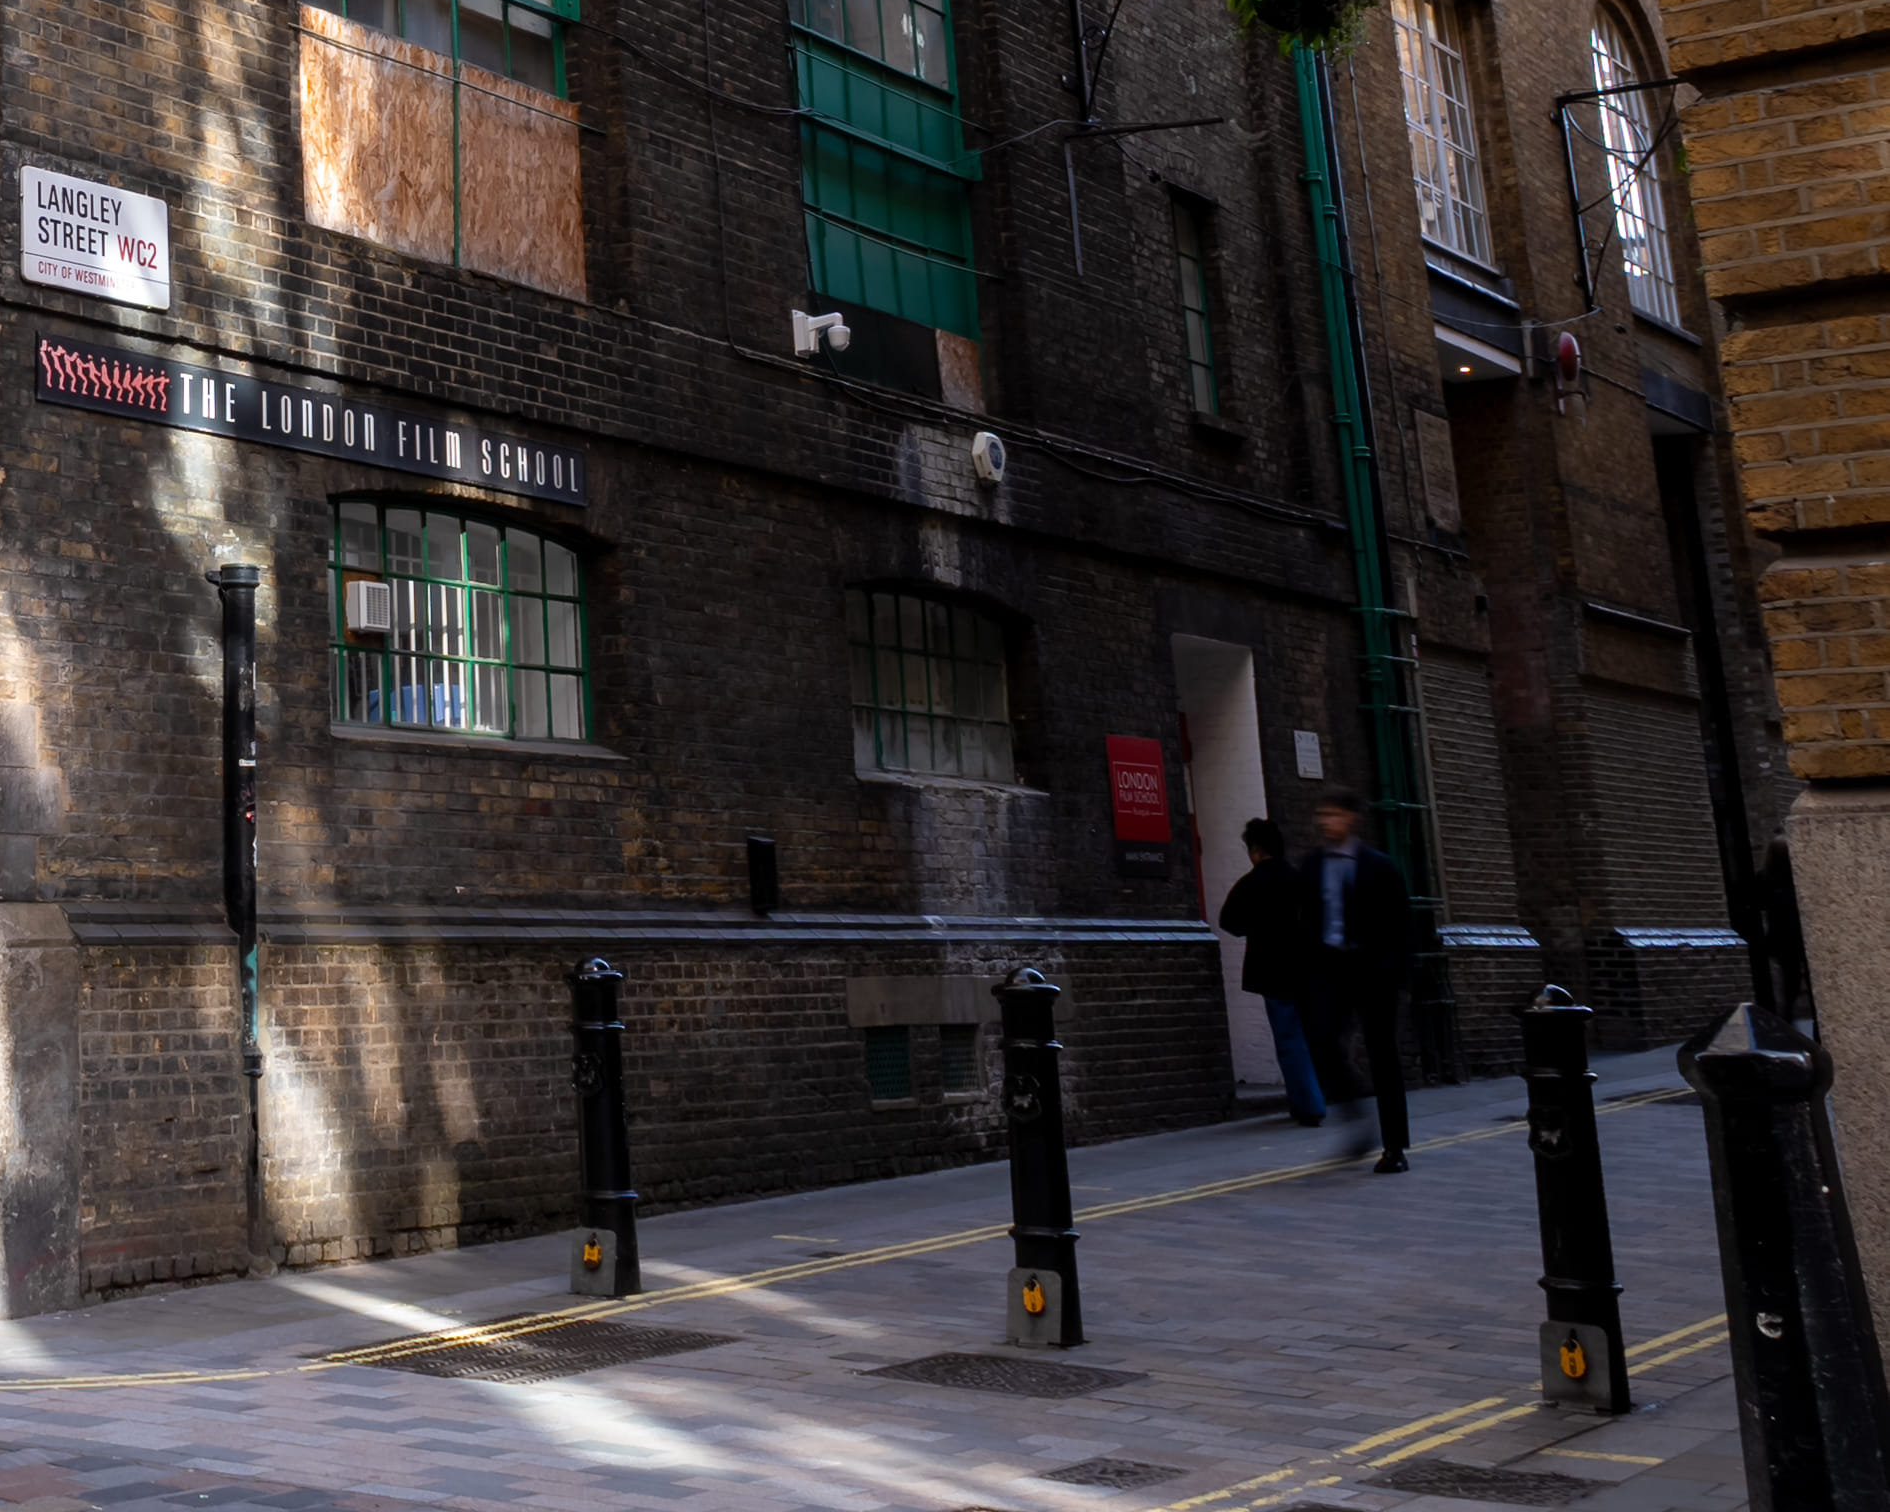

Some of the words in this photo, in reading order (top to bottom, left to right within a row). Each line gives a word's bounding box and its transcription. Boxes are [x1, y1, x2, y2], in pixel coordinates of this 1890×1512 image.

[37, 181, 122, 226] LANGLEY
[38, 216, 109, 257] STREET
[117, 234, 157, 270] WC2
[38, 261, 58, 276] CITY
[61, 267, 72, 280] OF
[180, 372, 236, 423] THE
[481, 439, 578, 493] SCHOOL
[1118, 771, 1158, 790] LONDON
